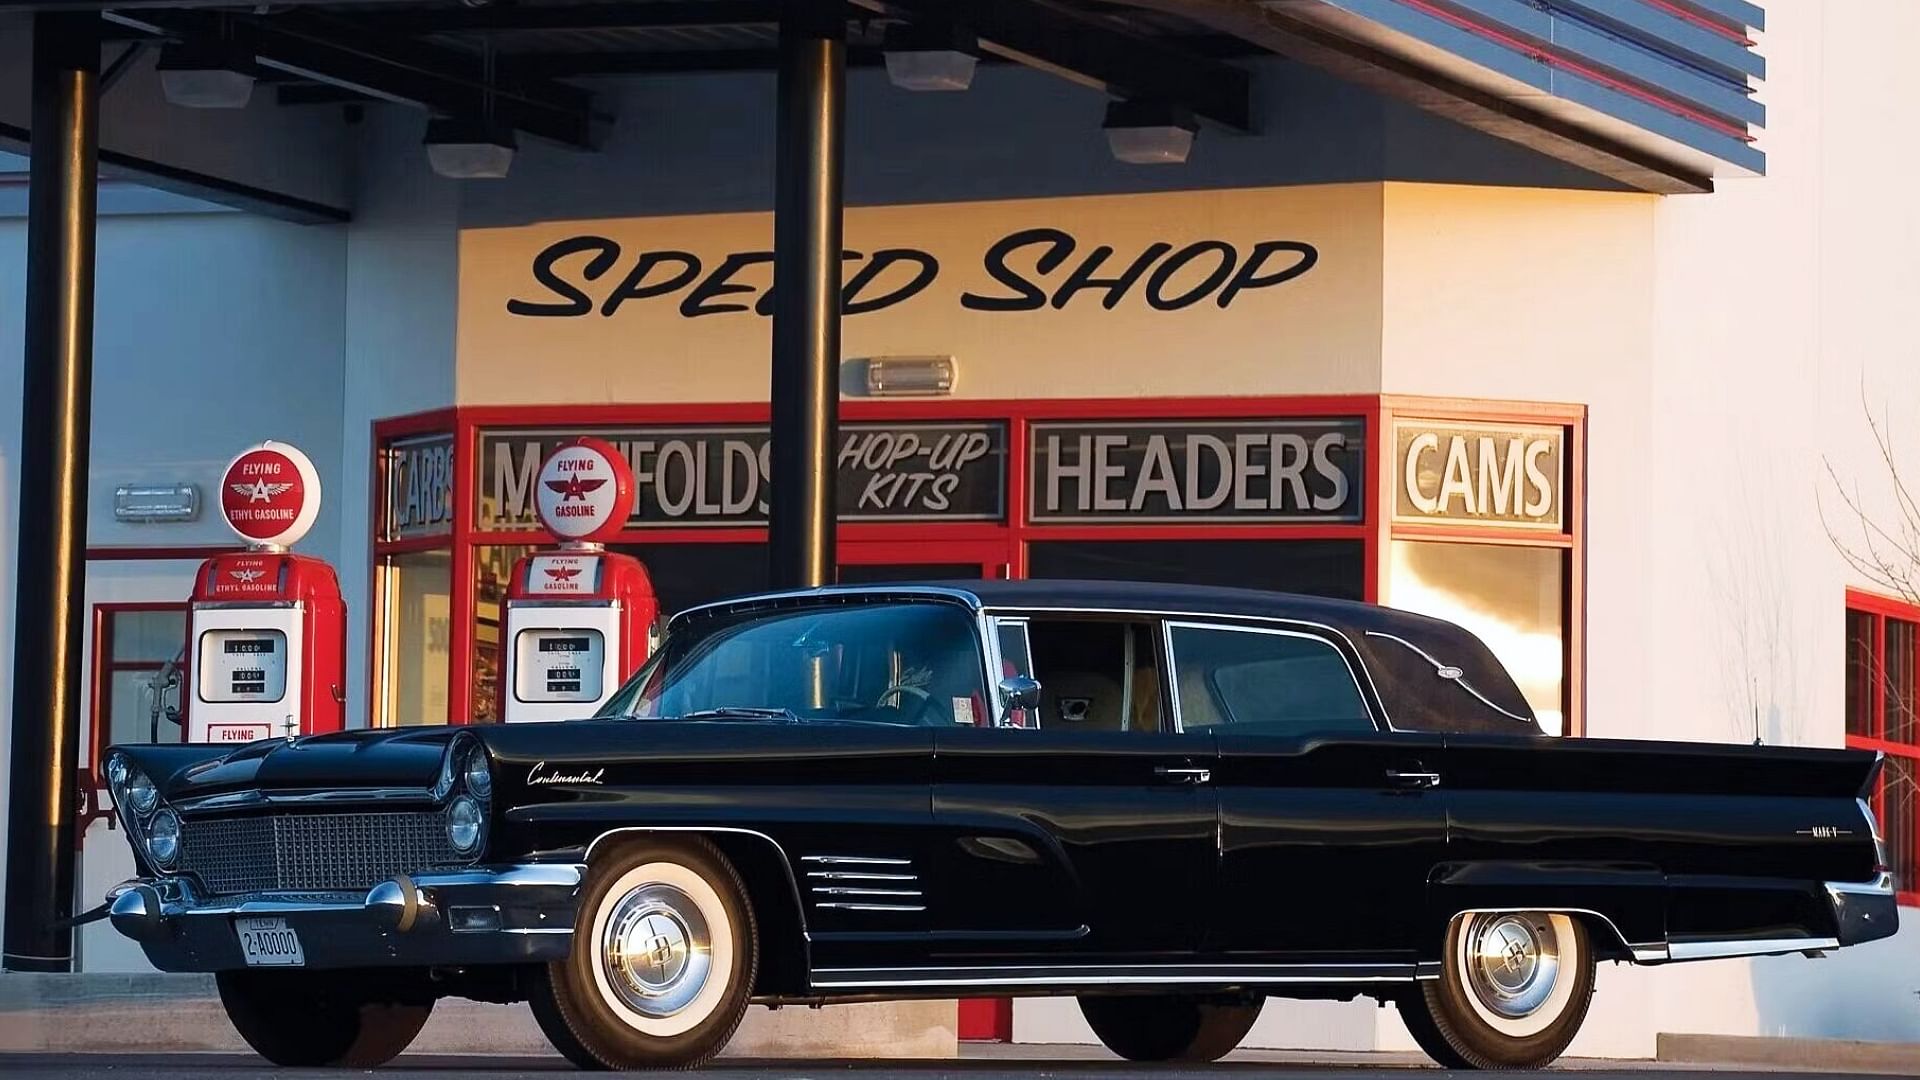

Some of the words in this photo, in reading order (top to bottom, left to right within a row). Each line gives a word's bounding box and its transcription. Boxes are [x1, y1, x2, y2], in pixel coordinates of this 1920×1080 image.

[960, 228, 1318, 311] SHOP
[838, 432, 990, 470] HOP-UP
[242, 463, 281, 475] FLYING
[557, 460, 594, 472] FLYING
[1047, 432, 1348, 511] HEADERS
[1405, 433, 1552, 517] CAMS
[858, 472, 960, 510] KITS
[230, 509, 253, 521] ETHYL
[255, 508, 294, 520] GASOLINE
[555, 505, 595, 517] GASOLINE
[216, 584, 239, 592] ETHYL
[242, 584, 277, 592] GASOLINE
[222, 730, 254, 740] FLYING
[527, 761, 604, 785] Continental
